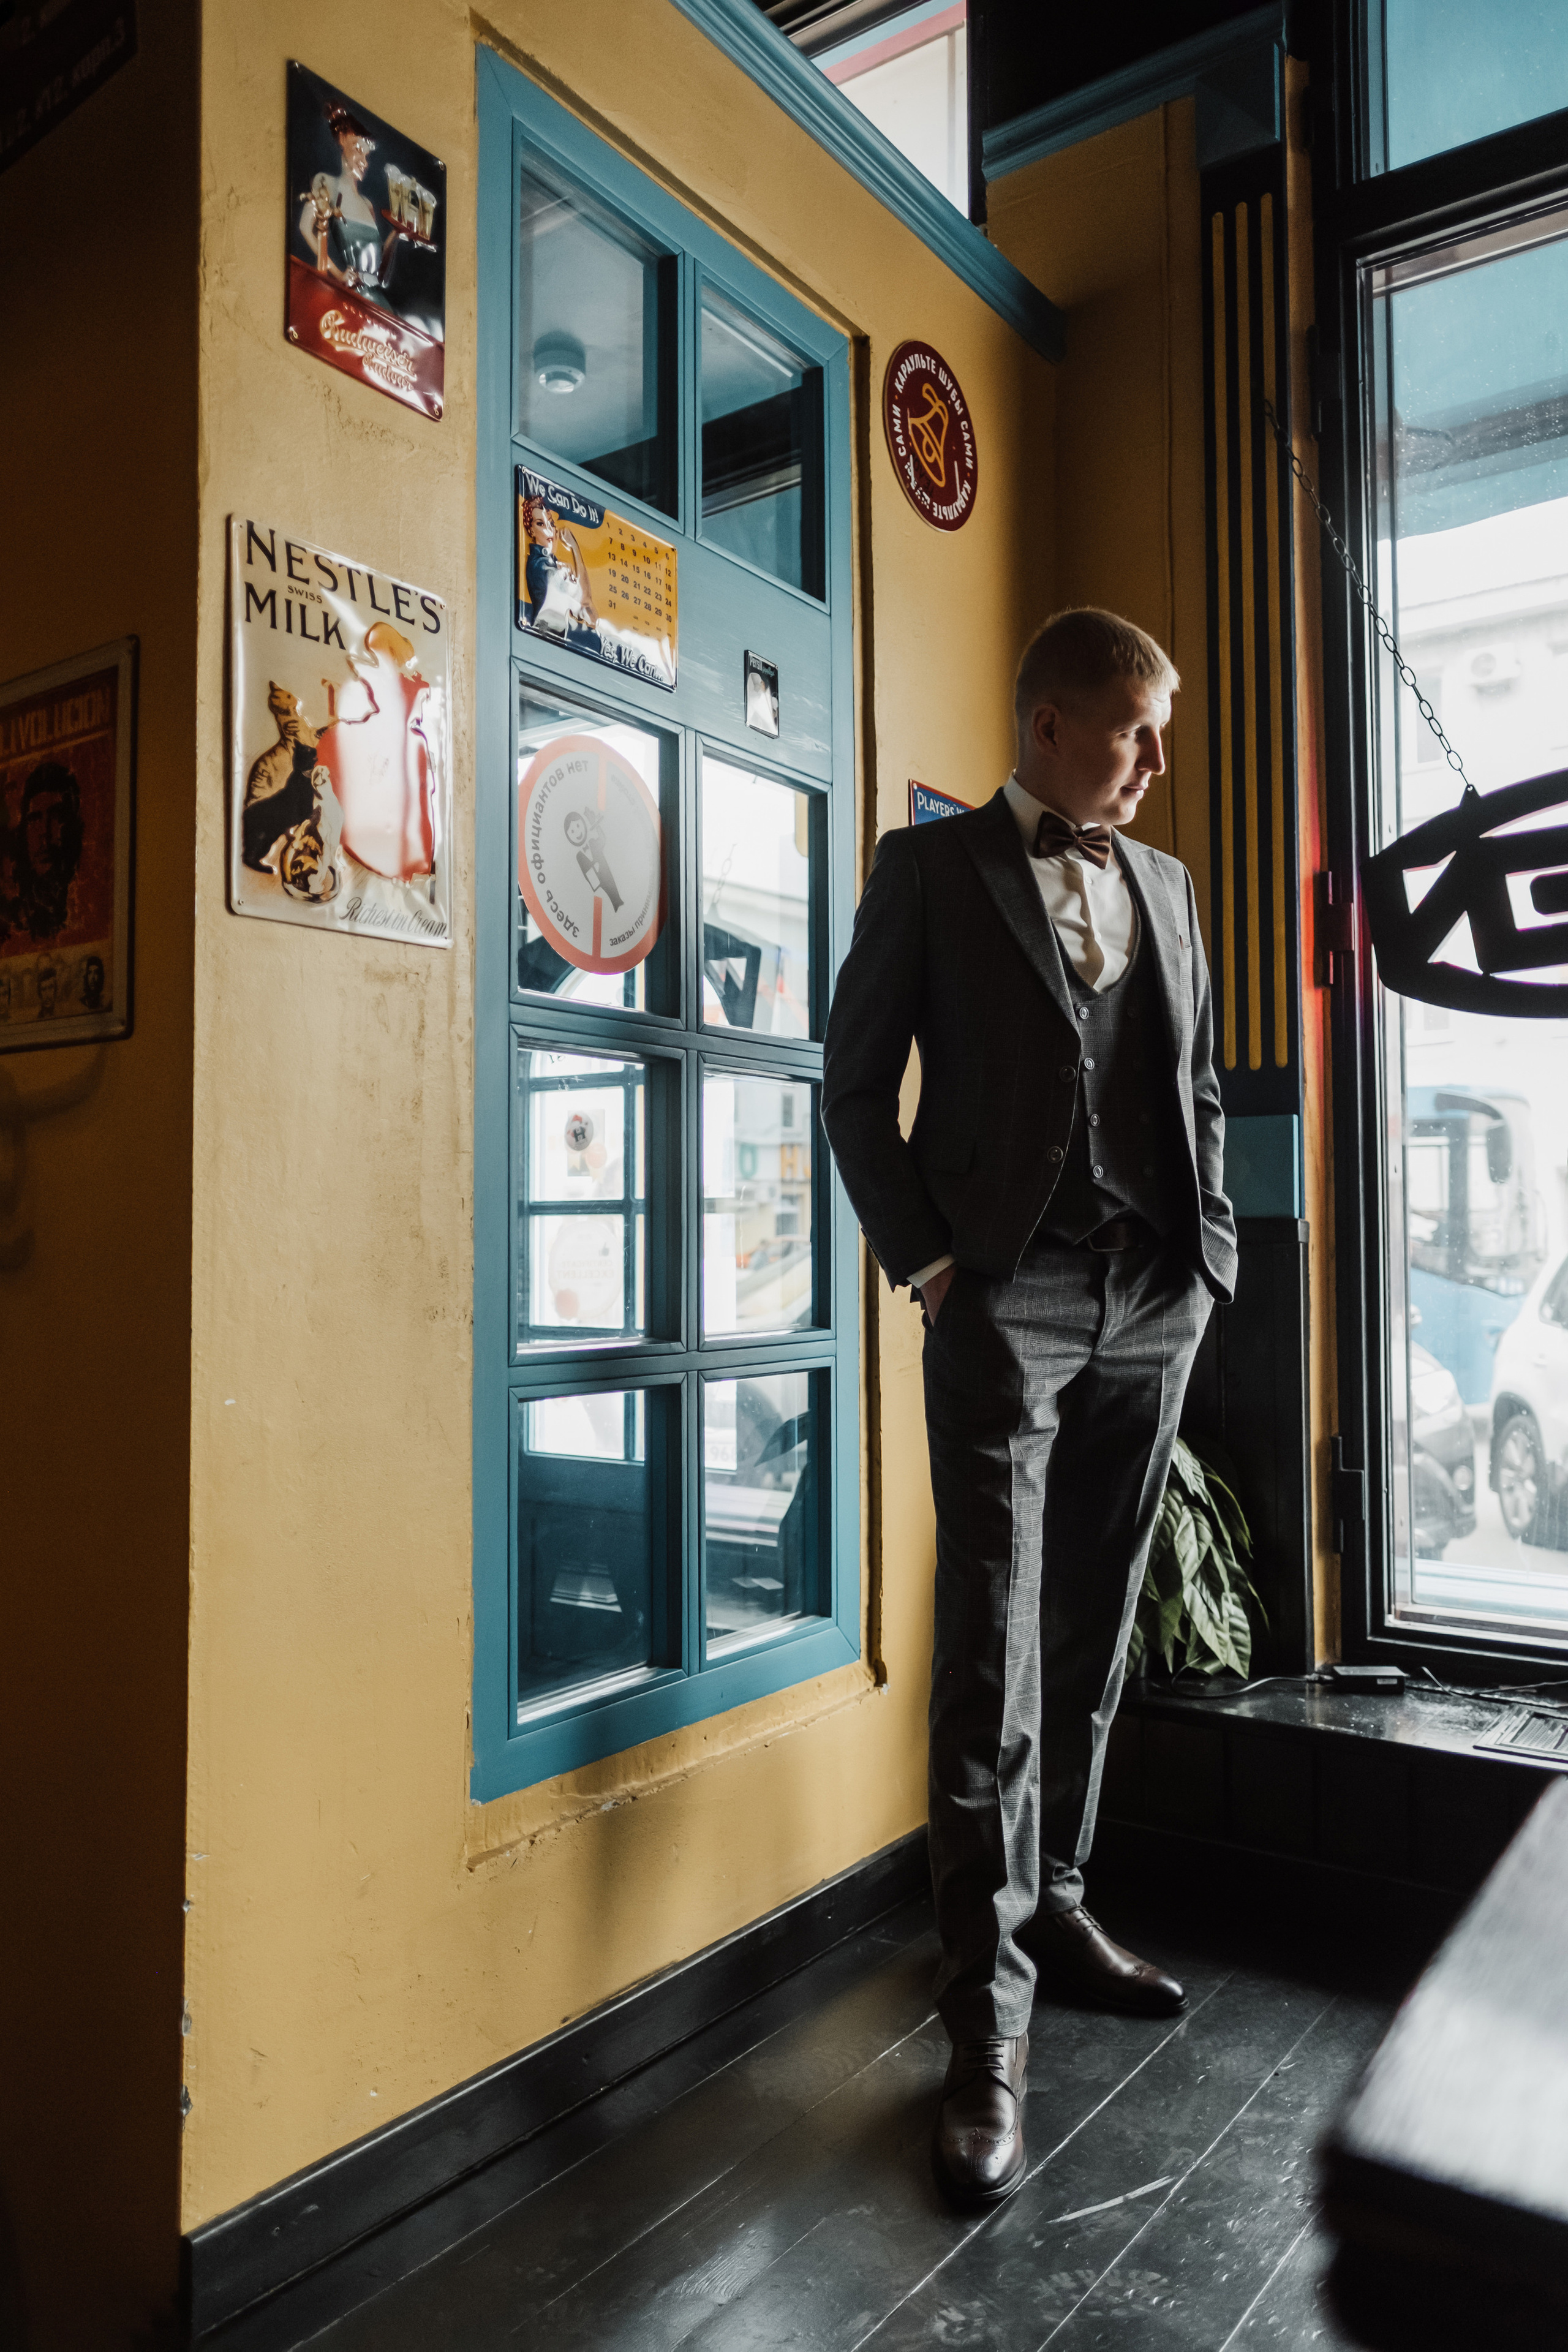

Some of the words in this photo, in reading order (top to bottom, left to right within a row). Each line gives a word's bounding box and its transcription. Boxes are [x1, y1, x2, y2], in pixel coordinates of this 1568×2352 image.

[320, 310, 415, 374] Budweiser
[363, 352, 414, 390] Budvar
[892, 404, 907, 456] САМИ
[894, 353, 937, 394] КАРАУЛЬТЕ
[938, 367, 963, 415] ШУБЫ
[960, 420, 974, 470] САМИ
[526, 473, 546, 497] We
[548, 484, 570, 510] Can
[571, 497, 587, 518] Do
[588, 504, 599, 524] It!
[246, 519, 440, 634] NESTLE'S
[608, 552, 616, 561] 13
[620, 558, 628, 567] 14
[633, 565, 640, 573] 15
[644, 571, 651, 579] 16
[655, 577, 662, 586] 17
[665, 583, 671, 592] 18
[643, 556, 650, 564] 10
[655, 562, 661, 571] 11
[665, 568, 671, 577] 12
[287, 585, 322, 604] SWISS
[608, 568, 616, 578] 19
[621, 574, 629, 584] 20
[633, 581, 641, 590] 21
[644, 586, 651, 595] 22
[655, 592, 662, 601] 23
[665, 598, 672, 607] 24
[608, 600, 616, 609] 31
[609, 584, 617, 594] 25
[621, 590, 629, 600] 26
[633, 597, 641, 605] 27
[644, 601, 652, 611] 28
[655, 607, 662, 616] 29
[665, 613, 672, 622] 30
[244, 581, 346, 650] MILK
[599, 635, 617, 663] Yes,
[619, 644, 637, 669] We
[566, 759, 589, 775] нет
[917, 791, 955, 817] PLAYER'S
[529, 767, 564, 884] официантов
[339, 897, 393, 929] Richest
[407, 910, 448, 938] Cream
[545, 889, 580, 939] здесь
[609, 925, 636, 947] заказы
